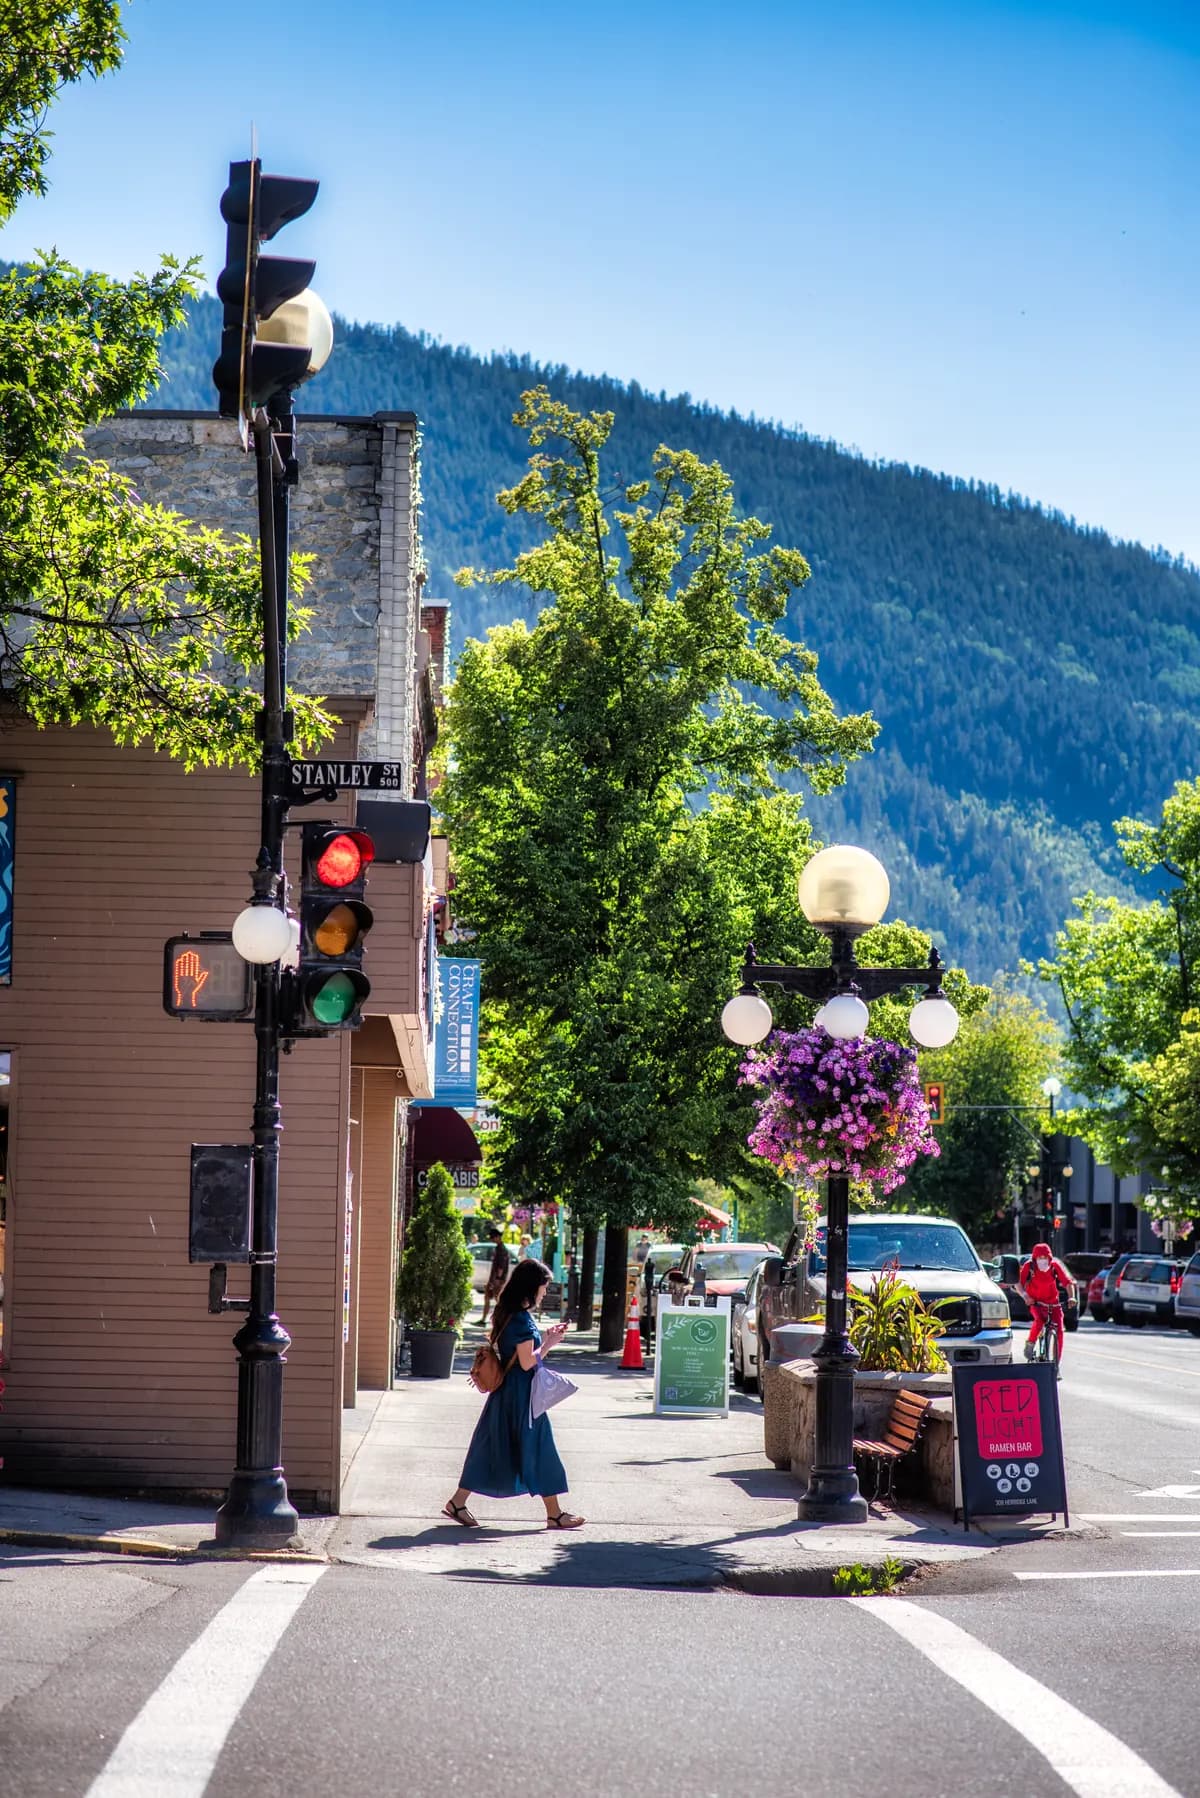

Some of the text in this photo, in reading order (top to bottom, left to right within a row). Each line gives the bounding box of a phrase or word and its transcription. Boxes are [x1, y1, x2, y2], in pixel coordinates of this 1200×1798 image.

[292, 763, 399, 786] STANLEY ST
[379, 777, 399, 787] 500
[462, 965, 475, 1023] CRAFT
[446, 965, 461, 1073] CONNECTION
[418, 1171, 478, 1187] CABIS
[980, 1386, 1033, 1413] RED
[982, 1416, 1037, 1438] LIGHT
[989, 1442, 1032, 1453] RAMEN BAR
